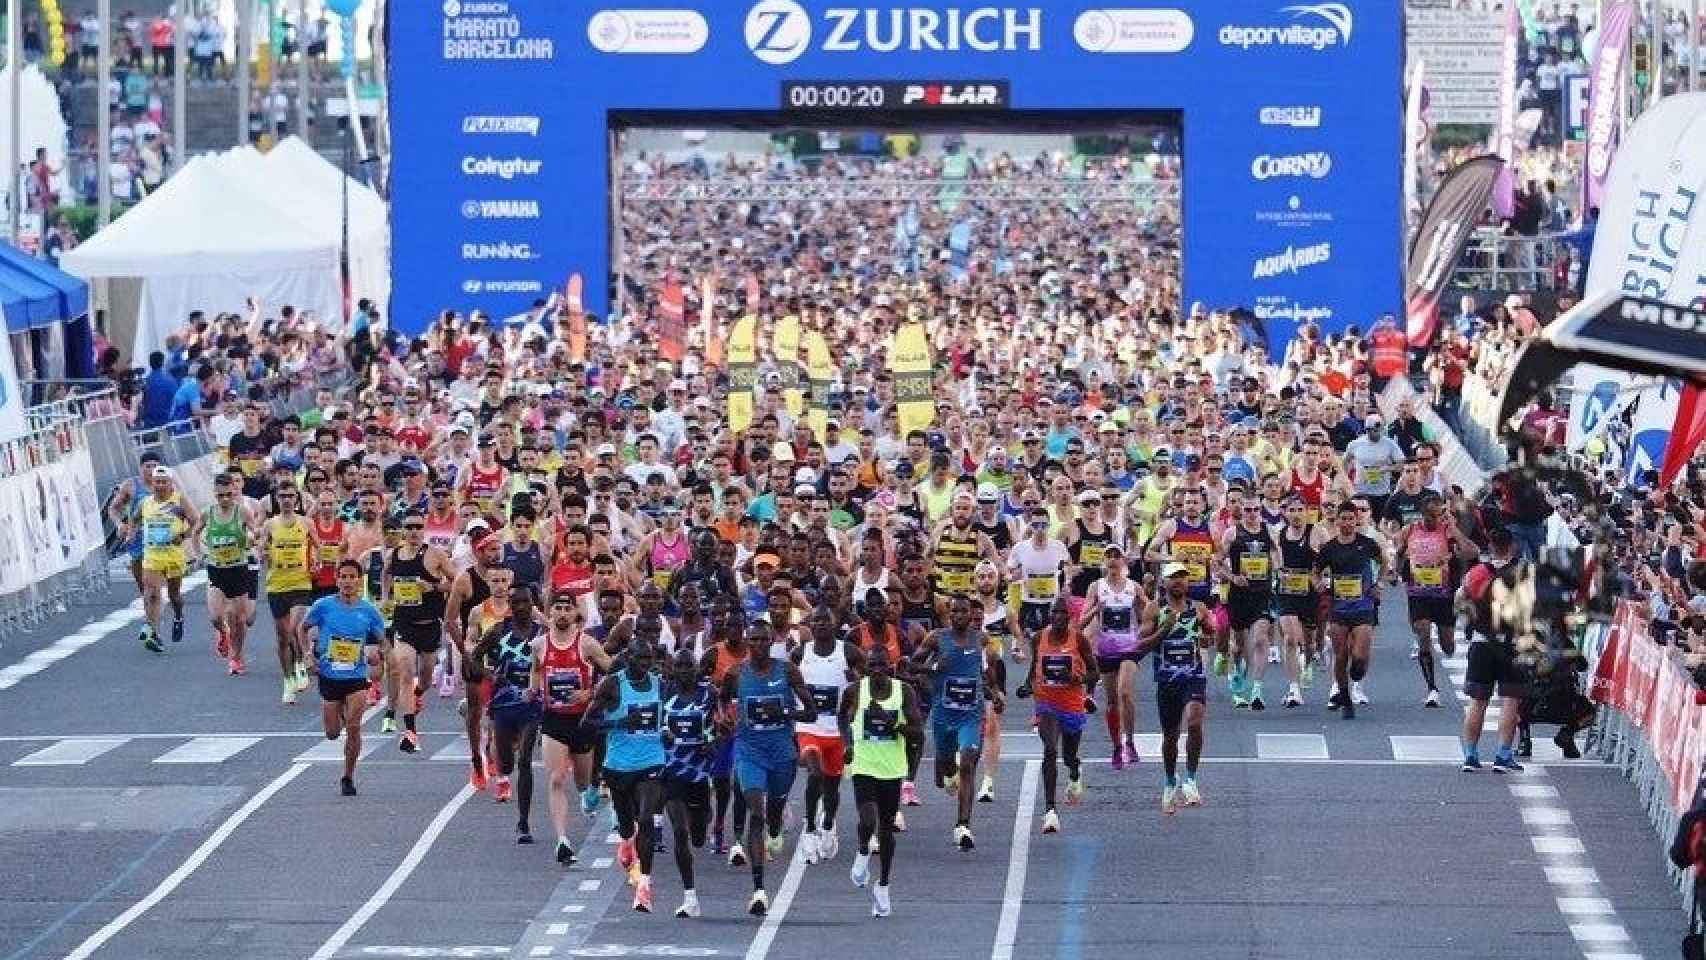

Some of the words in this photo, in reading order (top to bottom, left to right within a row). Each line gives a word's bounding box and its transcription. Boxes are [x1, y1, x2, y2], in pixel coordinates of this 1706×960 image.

[822, 8, 1041, 51] ZURICH
[1219, 23, 1338, 50] deporvillage
[444, 39, 552, 59] BARCELONA
[790, 86, 885, 107] 00:00:20
[903, 85, 999, 105] POLAR
[462, 156, 543, 179] Coingtur
[1252, 152, 1331, 179] CORNY
[480, 200, 539, 218] YAMAHA
[1253, 242, 1331, 280] AQUARIUS
